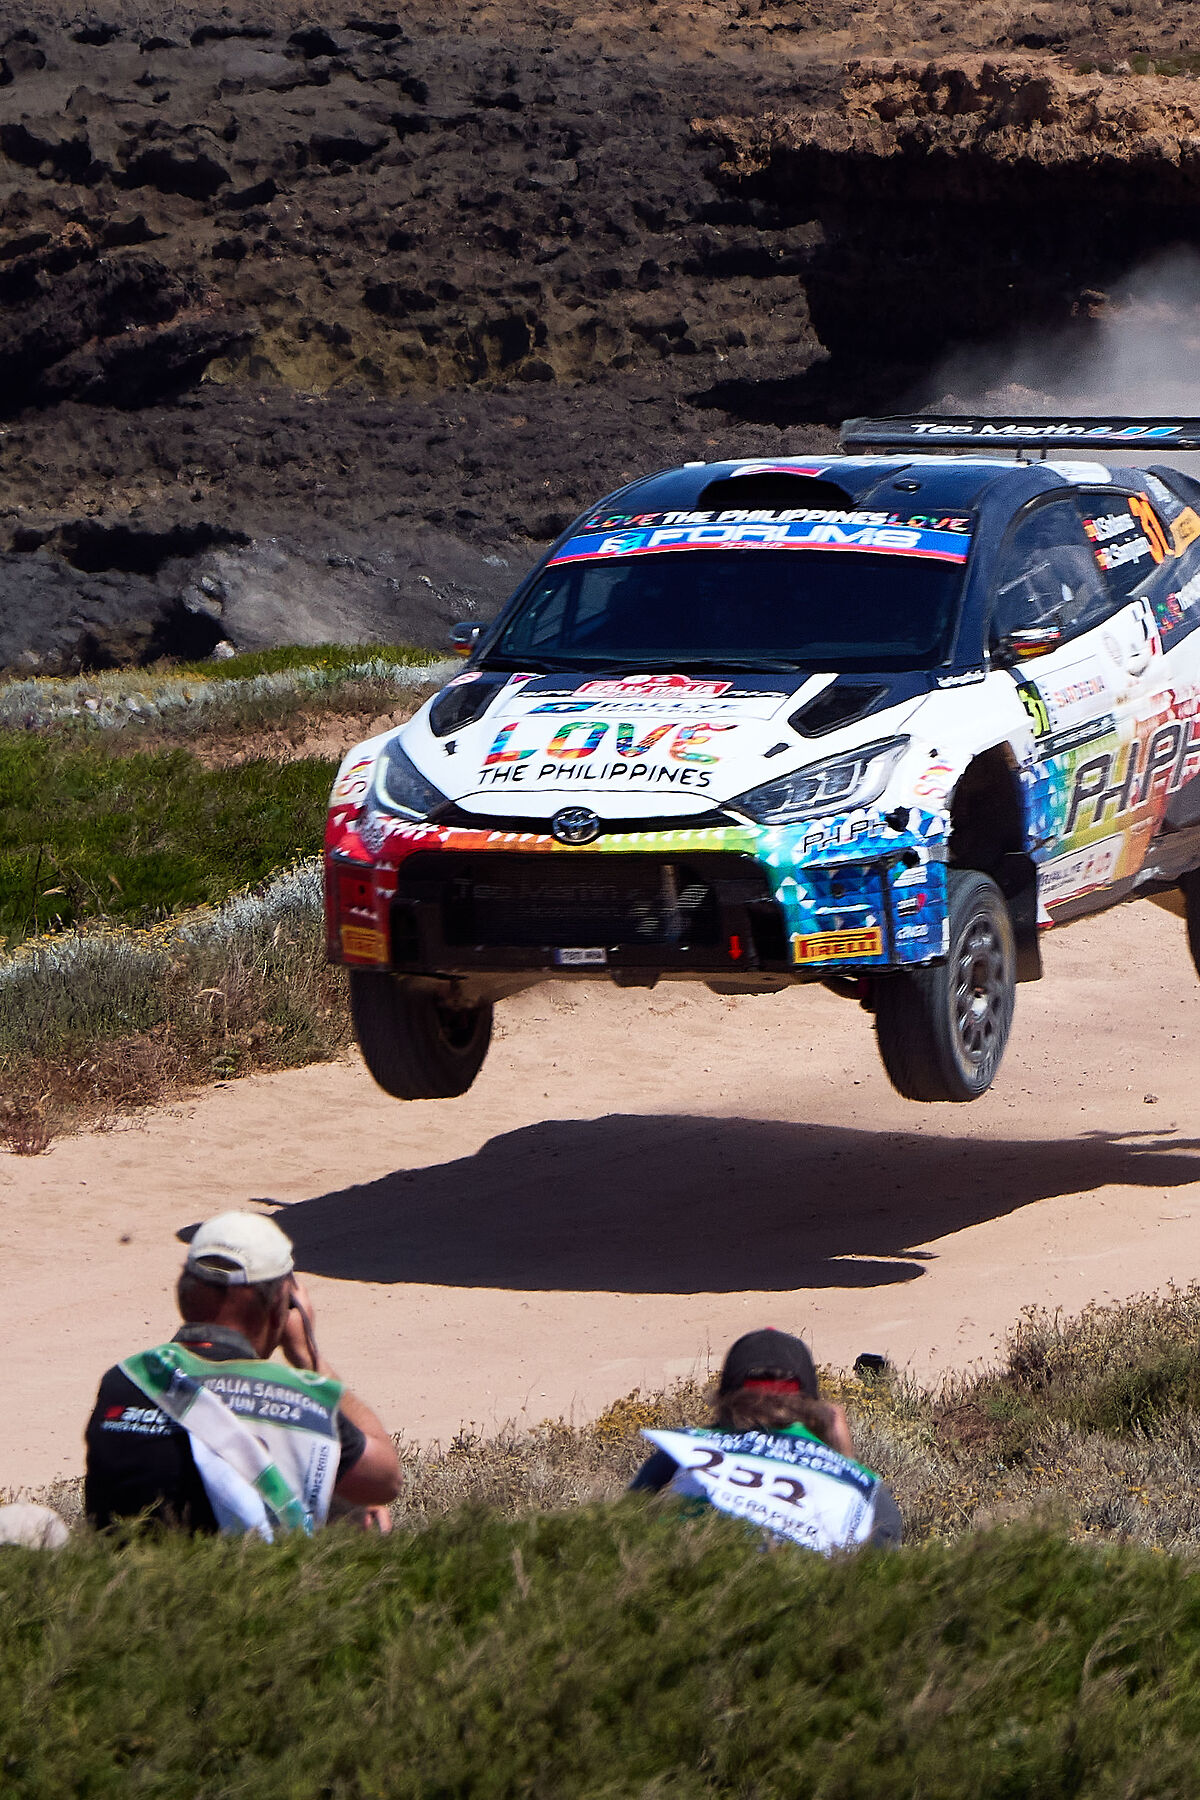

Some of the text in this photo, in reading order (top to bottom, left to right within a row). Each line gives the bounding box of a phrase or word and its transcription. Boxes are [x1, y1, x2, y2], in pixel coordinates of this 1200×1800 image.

[911, 423, 973, 434] Teo
[583, 508, 970, 532] LOVE THE PHILIPPINES LOVE
[647, 522, 922, 549] FORUM8
[483, 721, 740, 766] LOVE
[478, 762, 713, 787] THE PHILIPPINES
[800, 931, 878, 958] PIRELLI
[229, 1395, 302, 1420] JUN 2024
